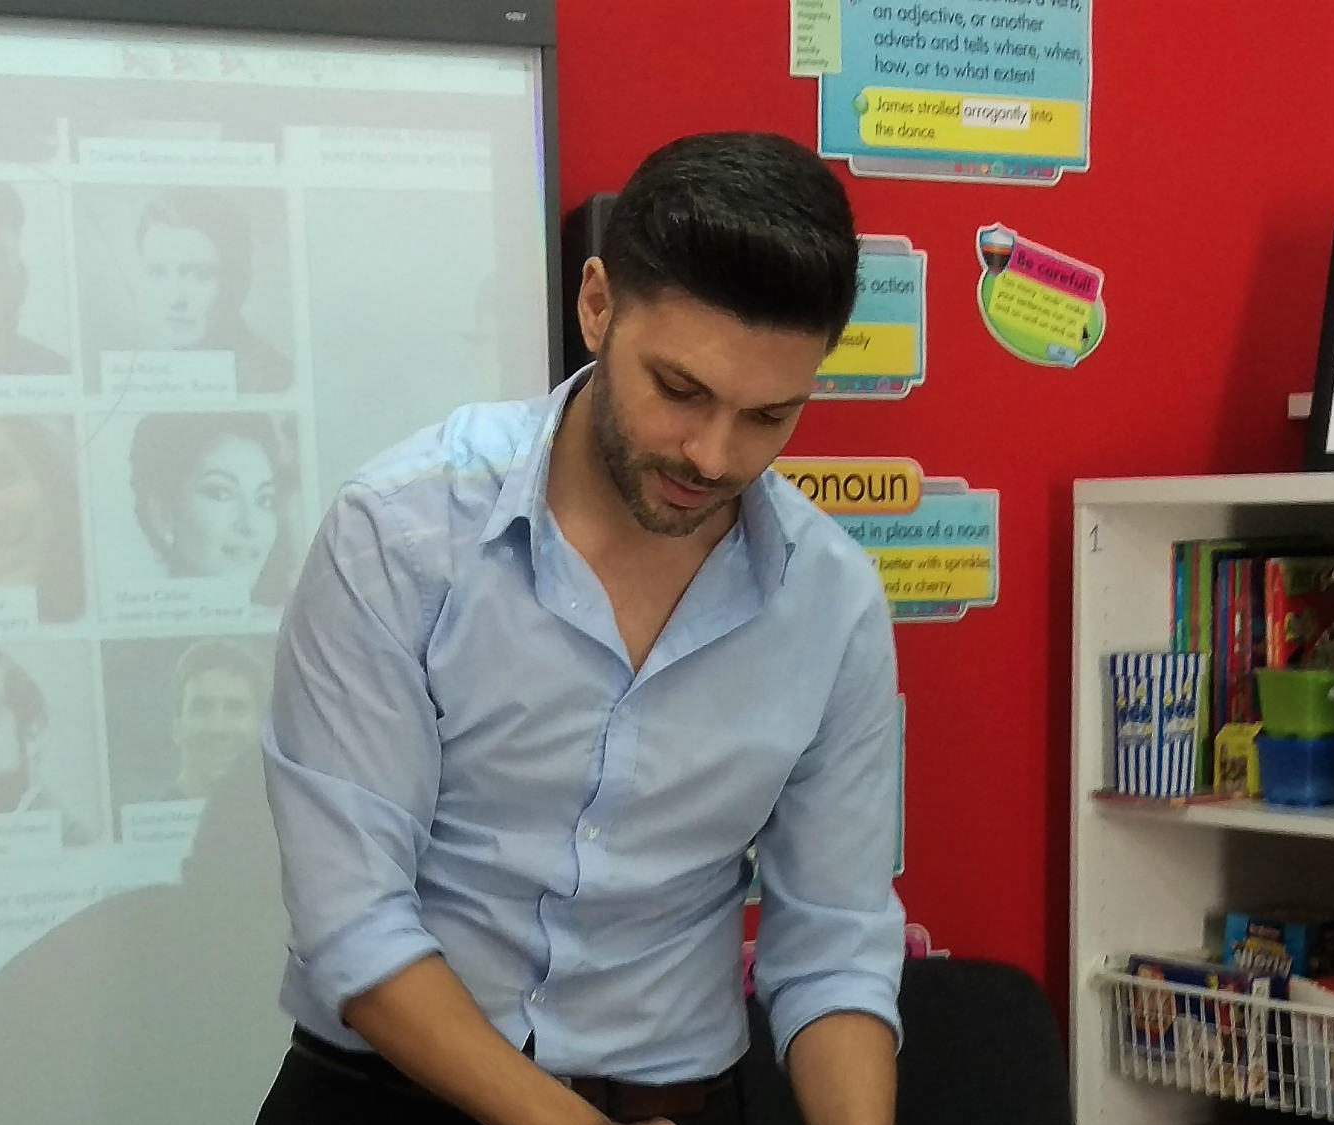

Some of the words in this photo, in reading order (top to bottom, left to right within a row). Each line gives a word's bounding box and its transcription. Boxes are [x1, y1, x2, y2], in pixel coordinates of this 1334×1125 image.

[873, 5, 892, 20] an
[898, 5, 966, 28] adjective,
[970, 13, 986, 28] or
[991, 13, 1044, 32] another
[874, 30, 926, 50] adverb
[931, 34, 959, 51] and
[964, 36, 990, 54] tells
[996, 39, 1040, 62] where,
[1044, 43, 1083, 66] when,
[875, 54, 909, 78] how,
[915, 61, 931, 75] or
[935, 61, 949, 77] to
[954, 62, 989, 80] what
[994, 66, 1035, 84] extent
[875, 95, 913, 114] James
[917, 99, 960, 117] strolled
[964, 103, 1028, 126] arrogantly
[1031, 108, 1053, 124] into
[875, 122, 894, 137] the
[871, 278, 915, 295] action
[870, 521, 882, 537] in
[887, 522, 923, 544] place
[927, 519, 941, 538] of
[944, 526, 955, 538] a
[957, 524, 990, 540] noun
